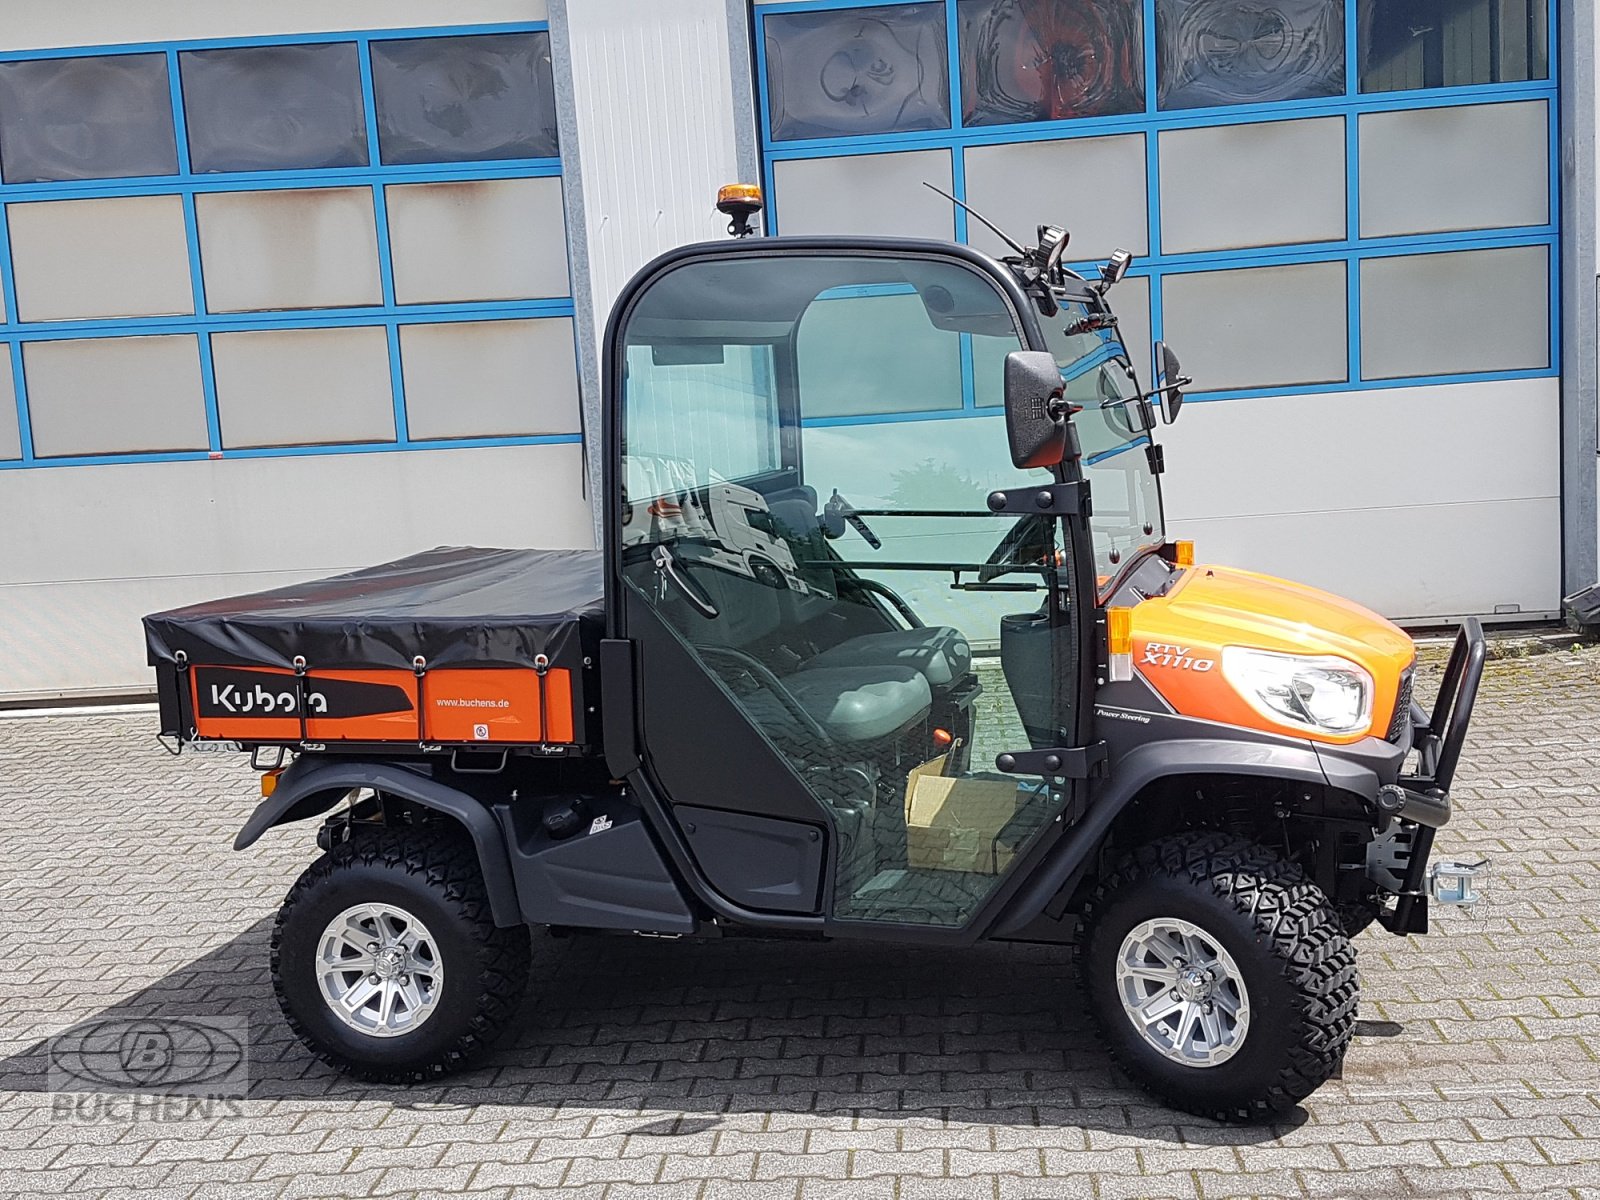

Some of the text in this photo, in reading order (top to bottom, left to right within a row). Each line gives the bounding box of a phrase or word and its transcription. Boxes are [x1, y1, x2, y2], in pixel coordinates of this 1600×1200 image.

[1145, 642, 1190, 655] RTV
[1140, 651, 1215, 672] X1110
[436, 698, 510, 708] www.buchens.de
[1096, 709, 1151, 724] Power Steering
